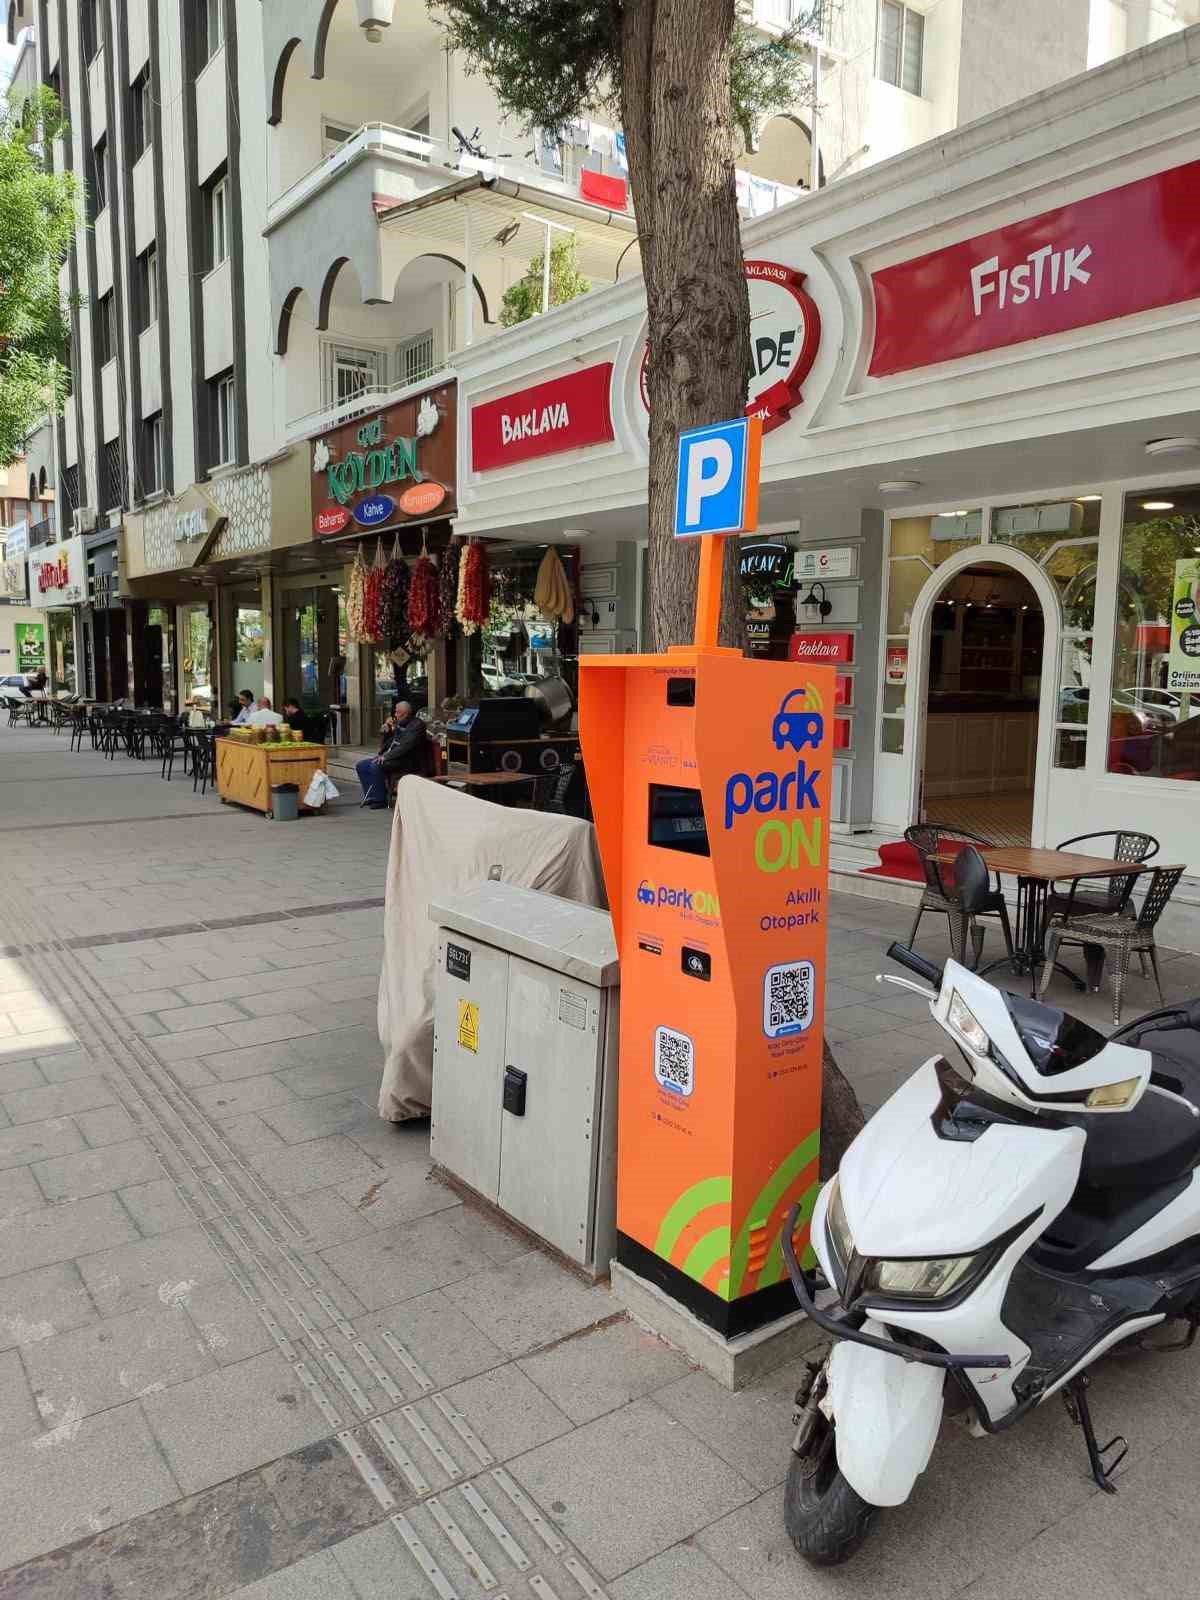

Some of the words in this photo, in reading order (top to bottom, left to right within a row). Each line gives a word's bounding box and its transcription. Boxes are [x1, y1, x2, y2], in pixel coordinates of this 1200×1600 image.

[745, 264, 788, 281] AKLAVASI
[970, 244, 1092, 316] FISTIK
[501, 402, 570, 446] BAKLAVA
[684, 438, 733, 526] P
[363, 503, 384, 518] Kahve
[319, 513, 345, 529] Baharat
[797, 640, 840, 656] Baklava
[1170, 679, 1200, 688] Gazian
[1171, 671, 1200, 682] Orijina
[724, 760, 822, 830] park
[754, 816, 822, 873] ON
[786, 887, 821, 906] Akıllı
[760, 909, 819, 931] Otopark
